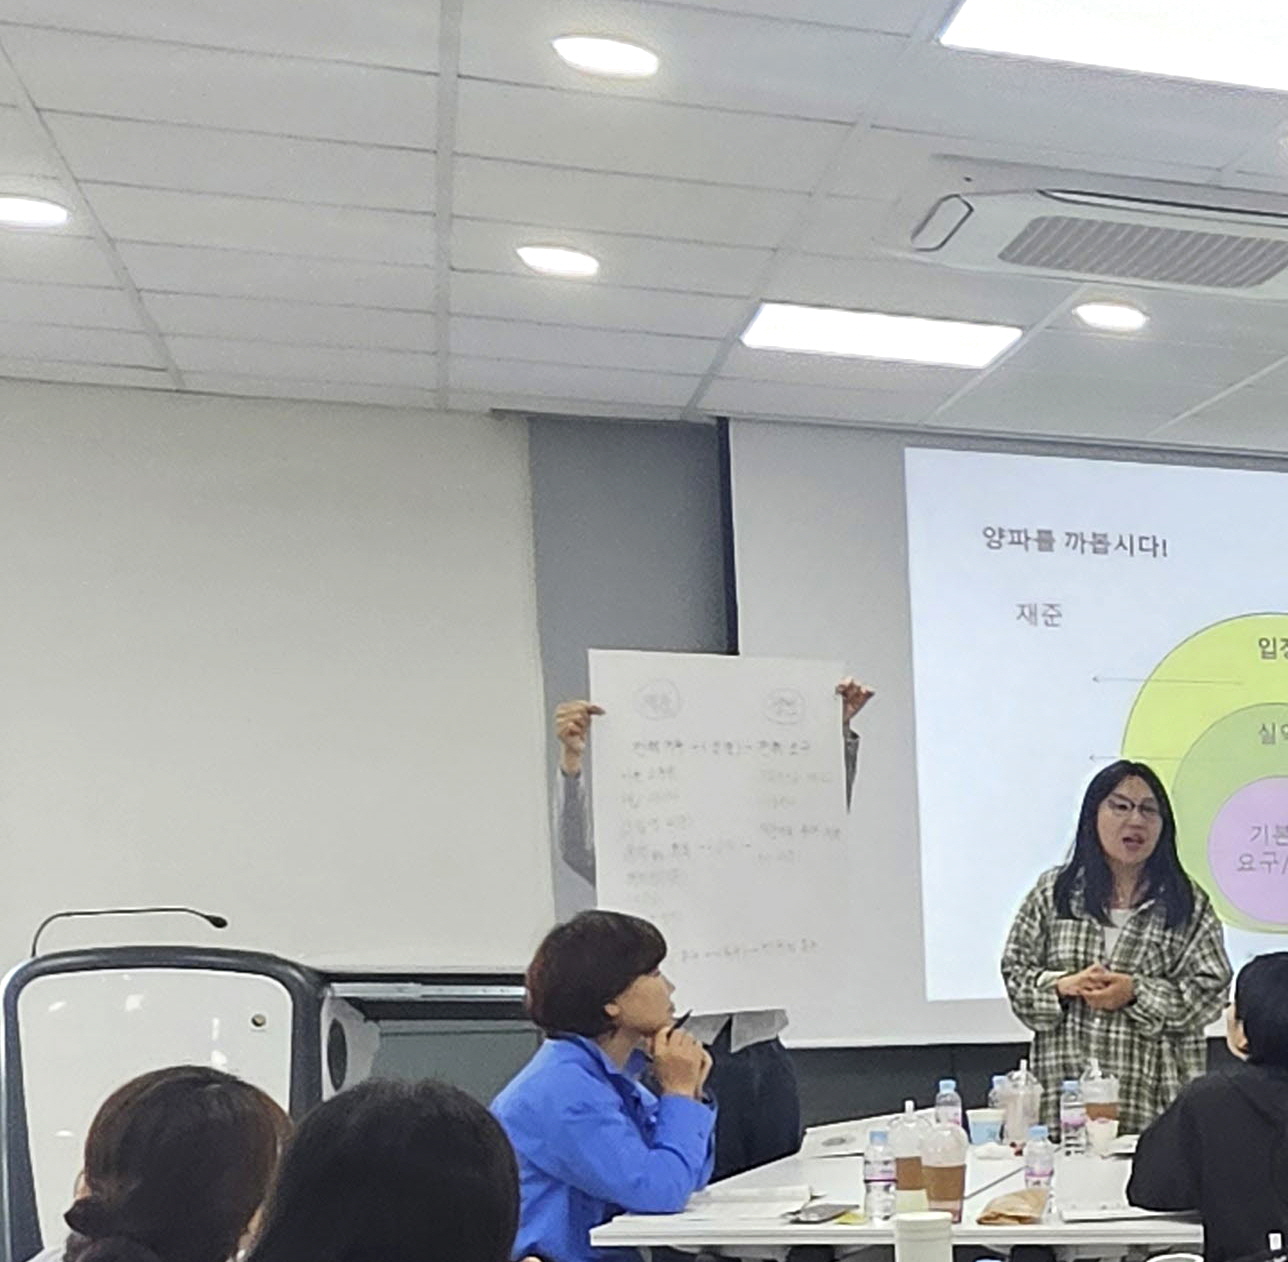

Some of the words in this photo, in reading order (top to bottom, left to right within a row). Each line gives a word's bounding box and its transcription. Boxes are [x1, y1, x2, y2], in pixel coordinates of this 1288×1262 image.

[981, 525, 1057, 552] 양파를
[1064, 531, 1168, 558] 까봅시다!
[1016, 602, 1063, 628] 재준
